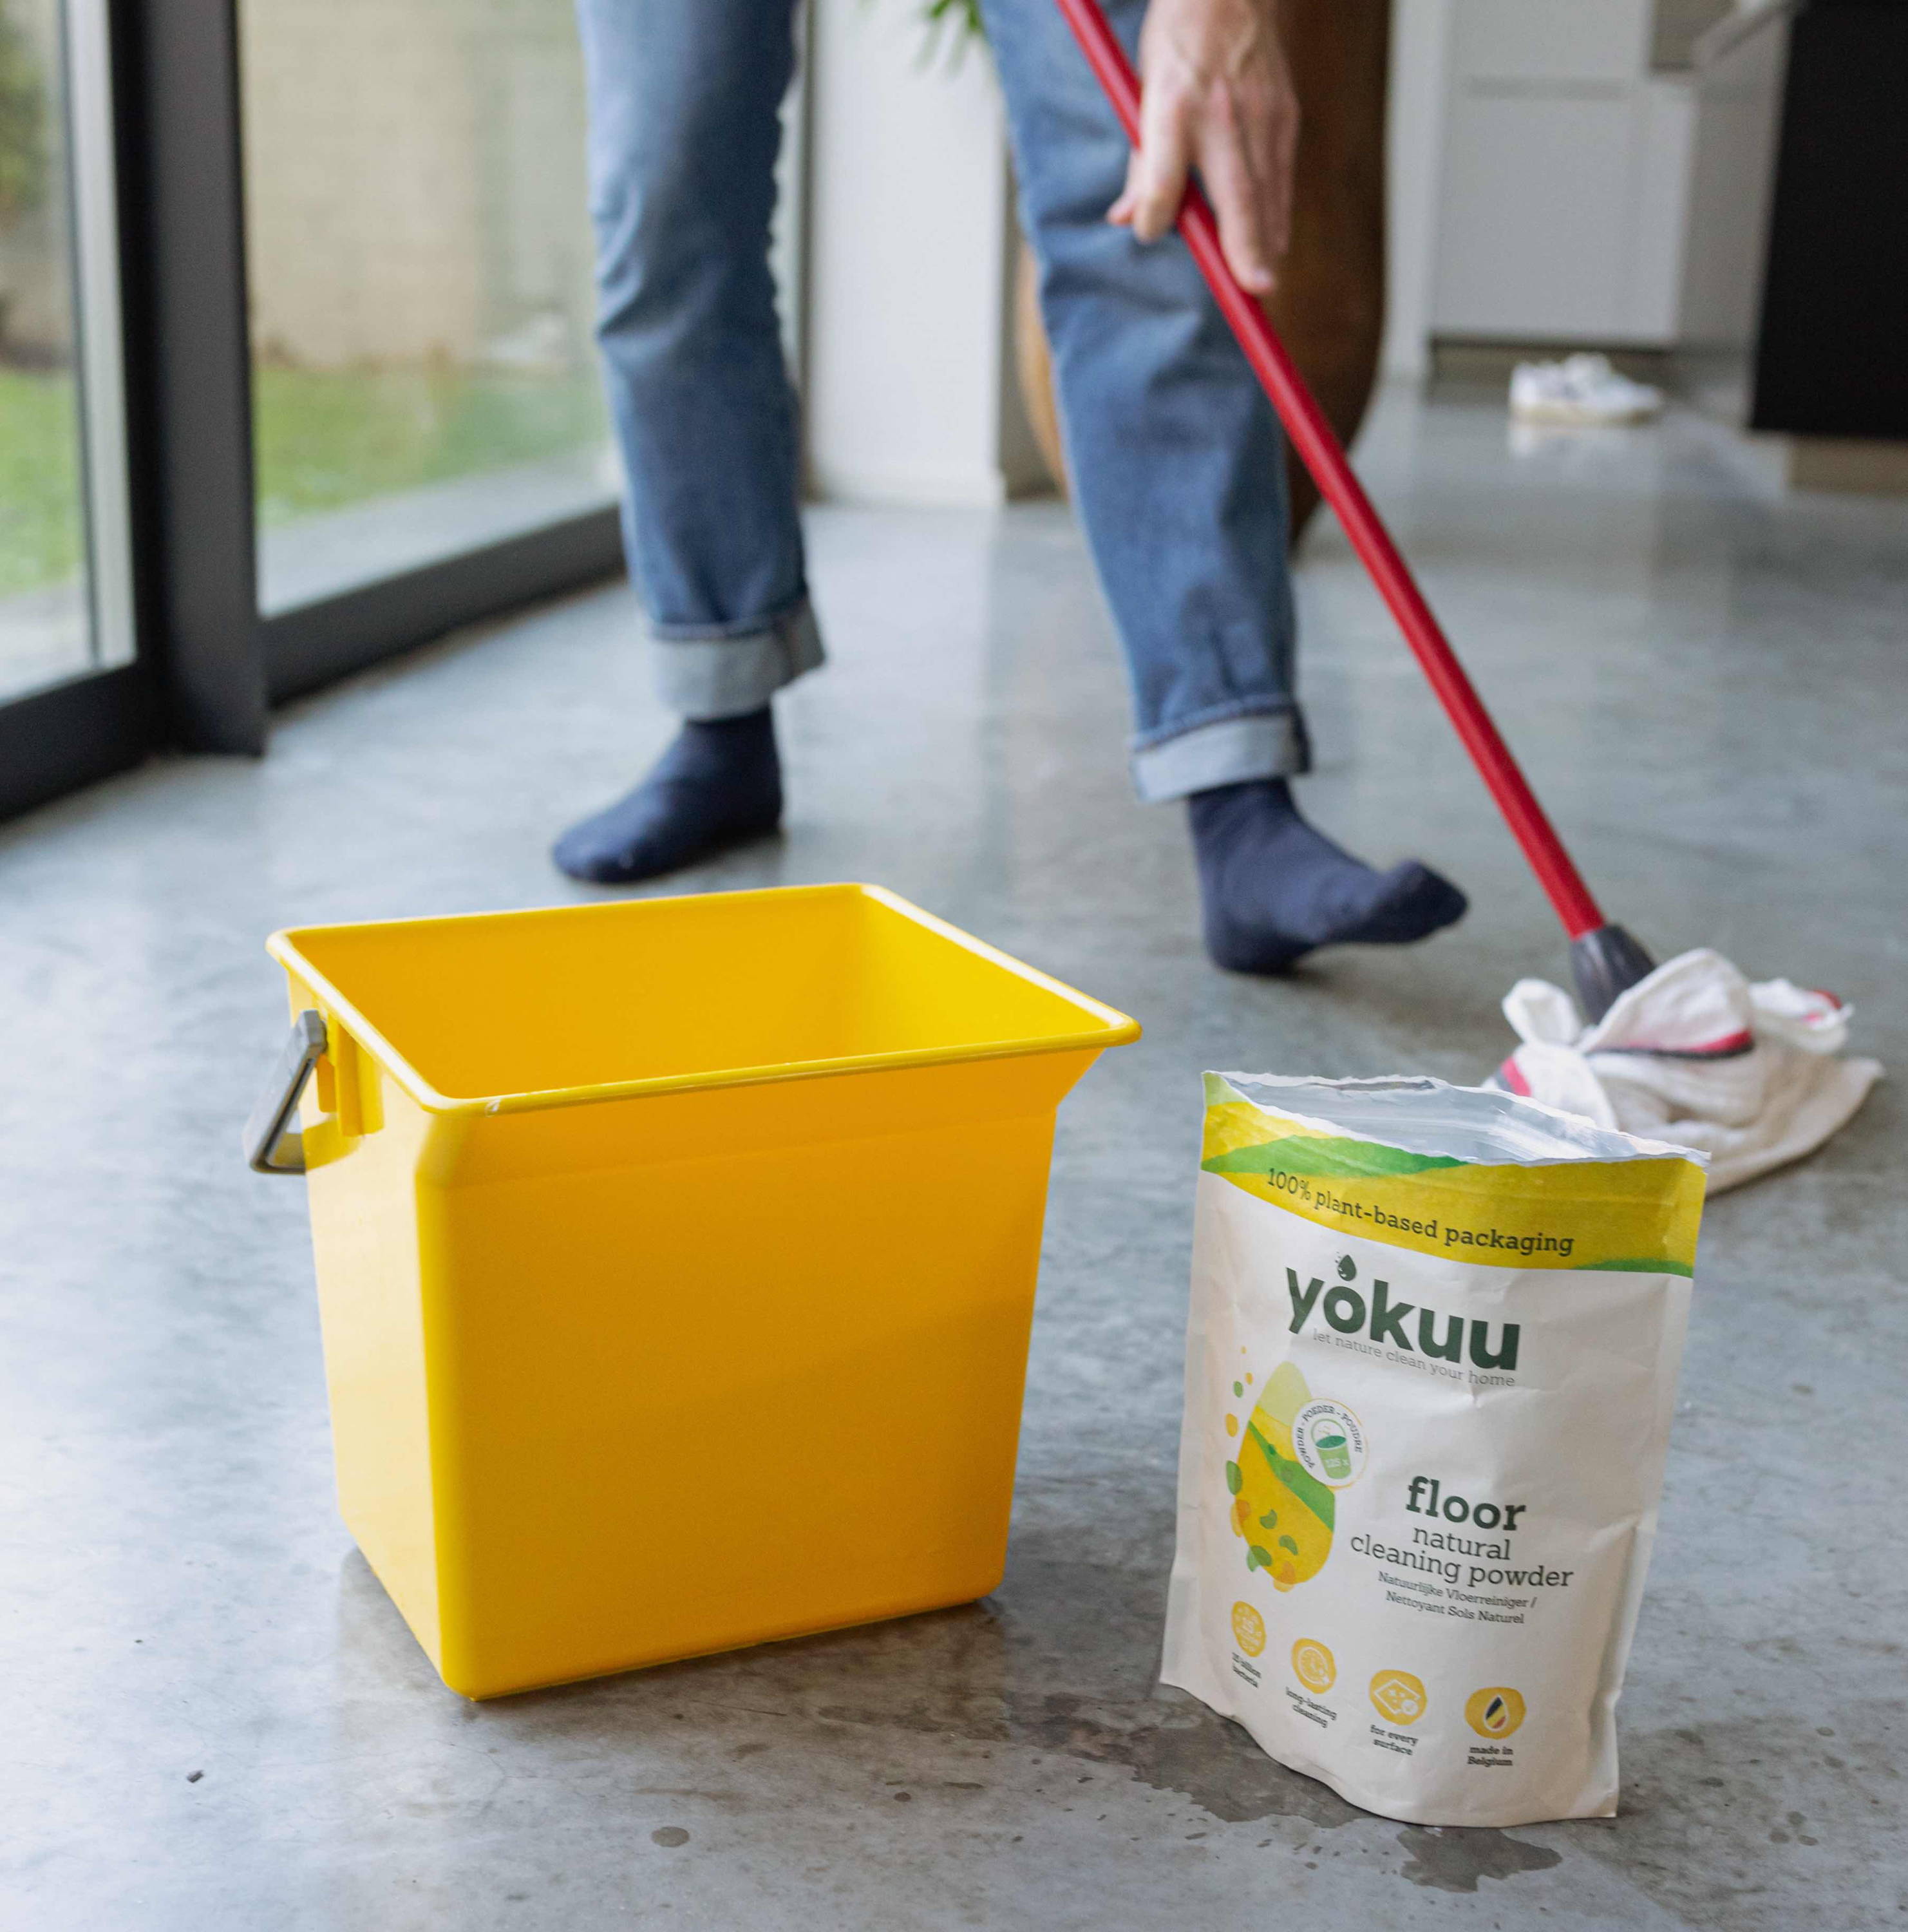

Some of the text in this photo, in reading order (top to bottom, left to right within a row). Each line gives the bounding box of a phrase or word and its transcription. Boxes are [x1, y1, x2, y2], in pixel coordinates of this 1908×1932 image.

[1267, 1168, 1574, 1257] 100% plant-based packaging
[1286, 1265, 1520, 1370] yokuu
[1312, 1328, 1515, 1387] let nature clean your home
[1406, 1475, 1526, 1531] floor
[1350, 1534, 1574, 1587] cleaning powder
[1413, 1526, 1510, 1560] natural
[1377, 1571, 1444, 1596] Natuurlijke
[1446, 1588, 1529, 1609] Vloerreiniger
[1386, 1590, 1525, 1624] Nettoyant Sols Naturel
[1370, 1724, 1419, 1747] for every
[1373, 1739, 1413, 1756] surface
[1469, 1745, 1500, 1755] made
